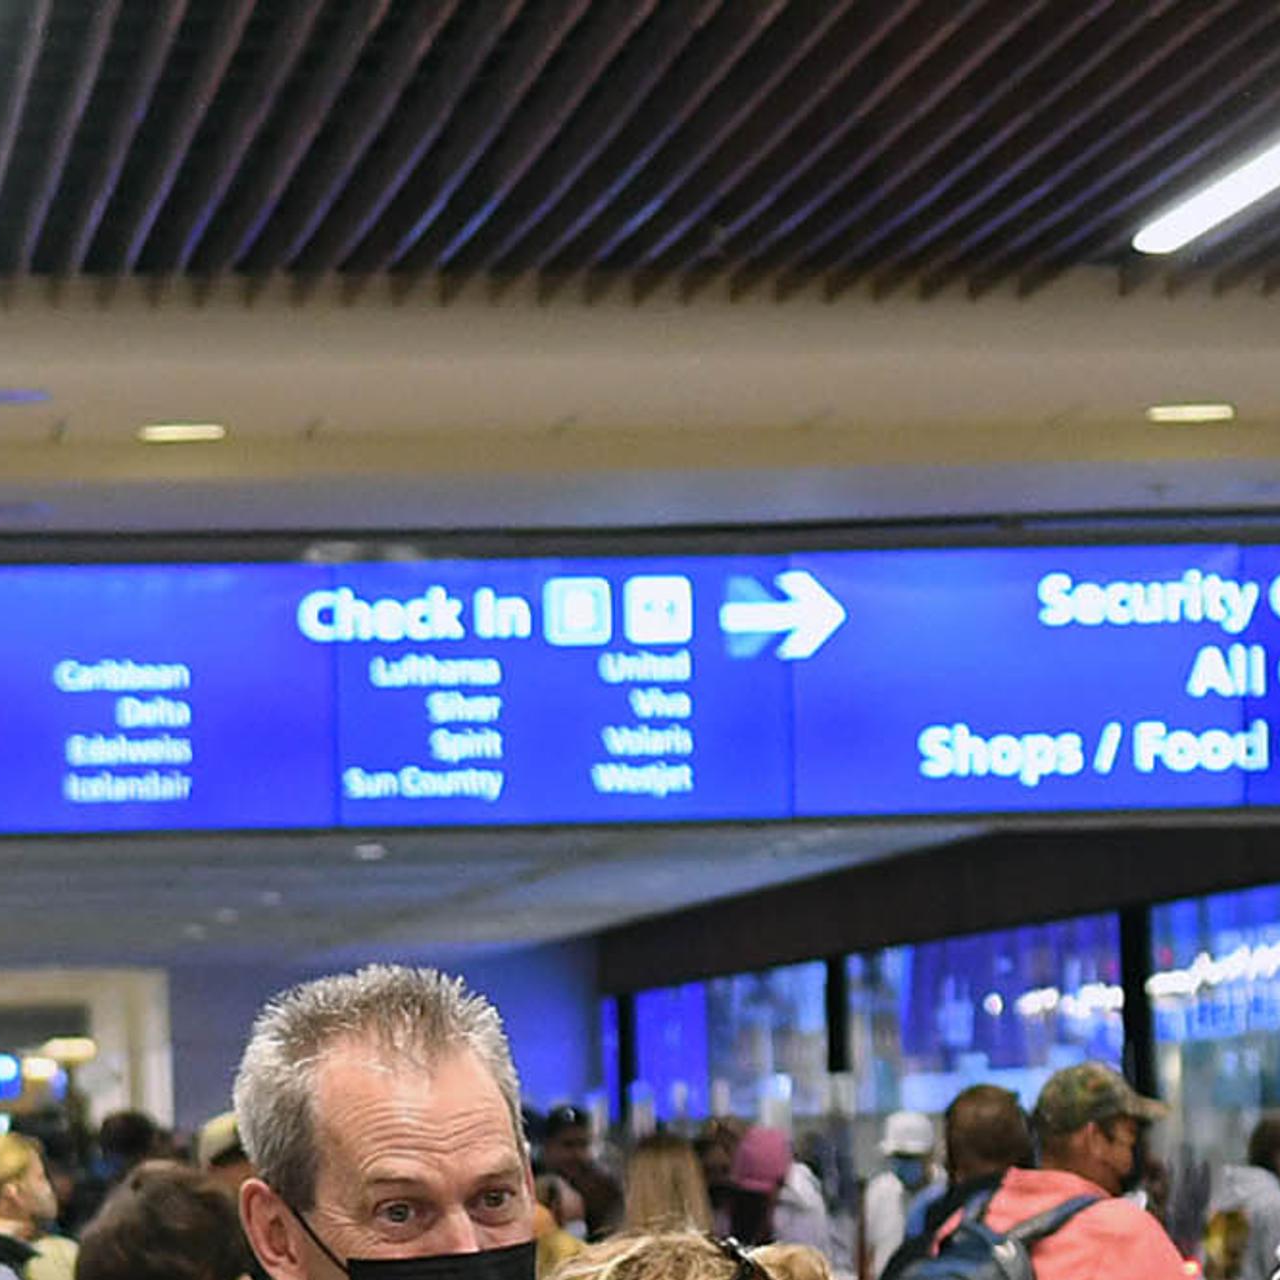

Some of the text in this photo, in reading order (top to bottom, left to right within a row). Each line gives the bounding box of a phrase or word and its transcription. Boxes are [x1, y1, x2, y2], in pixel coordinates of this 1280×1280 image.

[296, 584, 532, 641] Check In
[1038, 569, 1258, 633] Security
[1186, 643, 1264, 699] All
[918, 724, 1083, 786] Shops
[1094, 724, 1121, 772] /
[1133, 720, 1269, 772] Food
[342, 766, 398, 798] Sun
